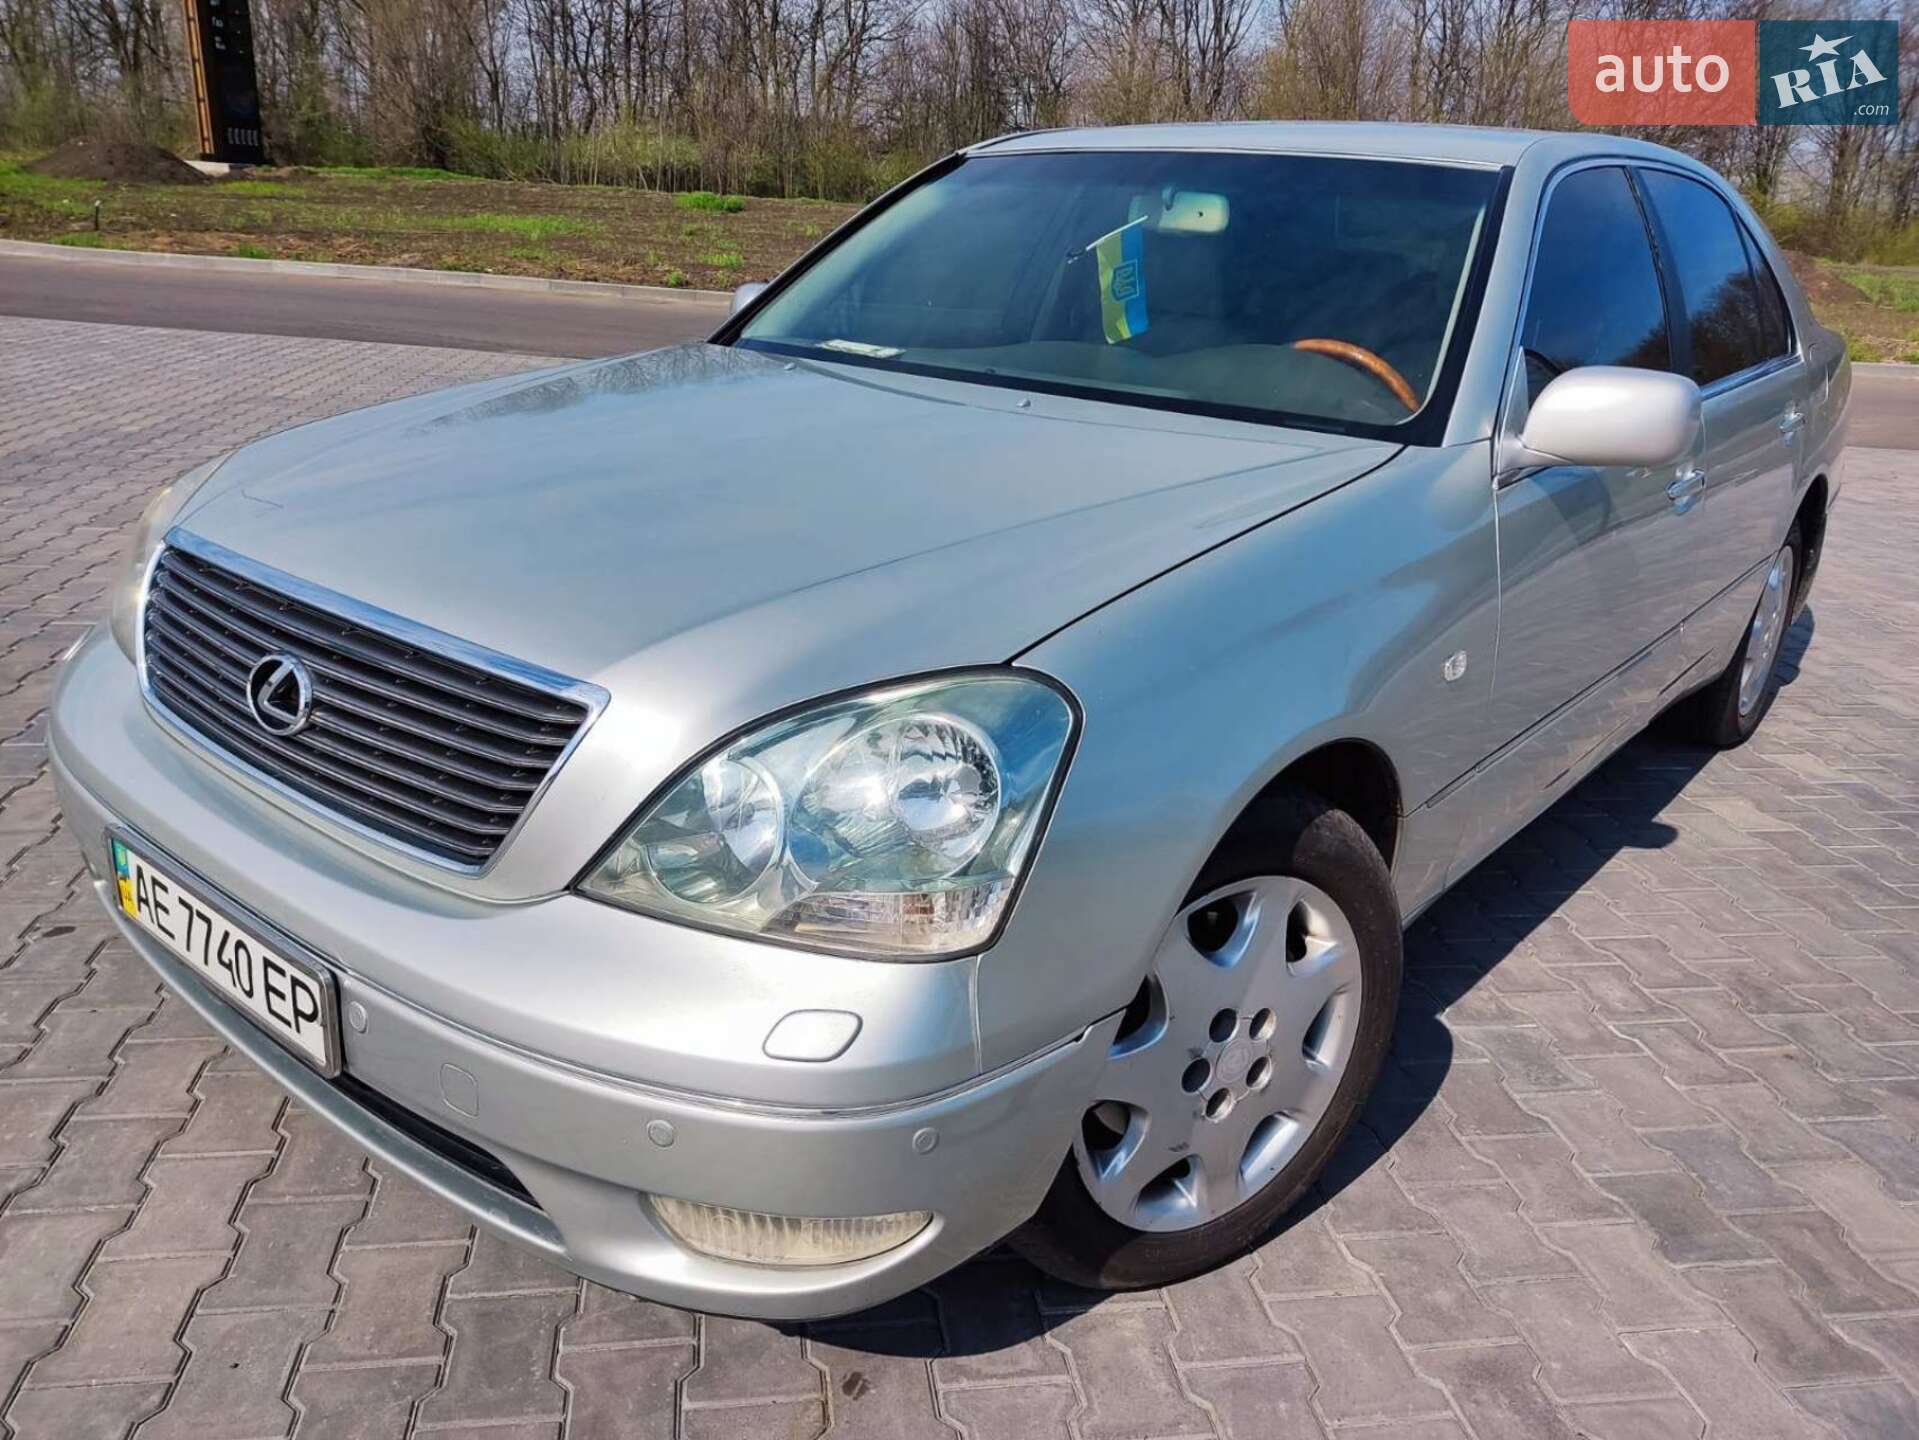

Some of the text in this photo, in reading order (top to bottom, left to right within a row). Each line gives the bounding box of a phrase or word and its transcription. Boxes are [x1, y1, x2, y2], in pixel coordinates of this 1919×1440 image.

[136, 864, 319, 1034] AE 7740 EP
